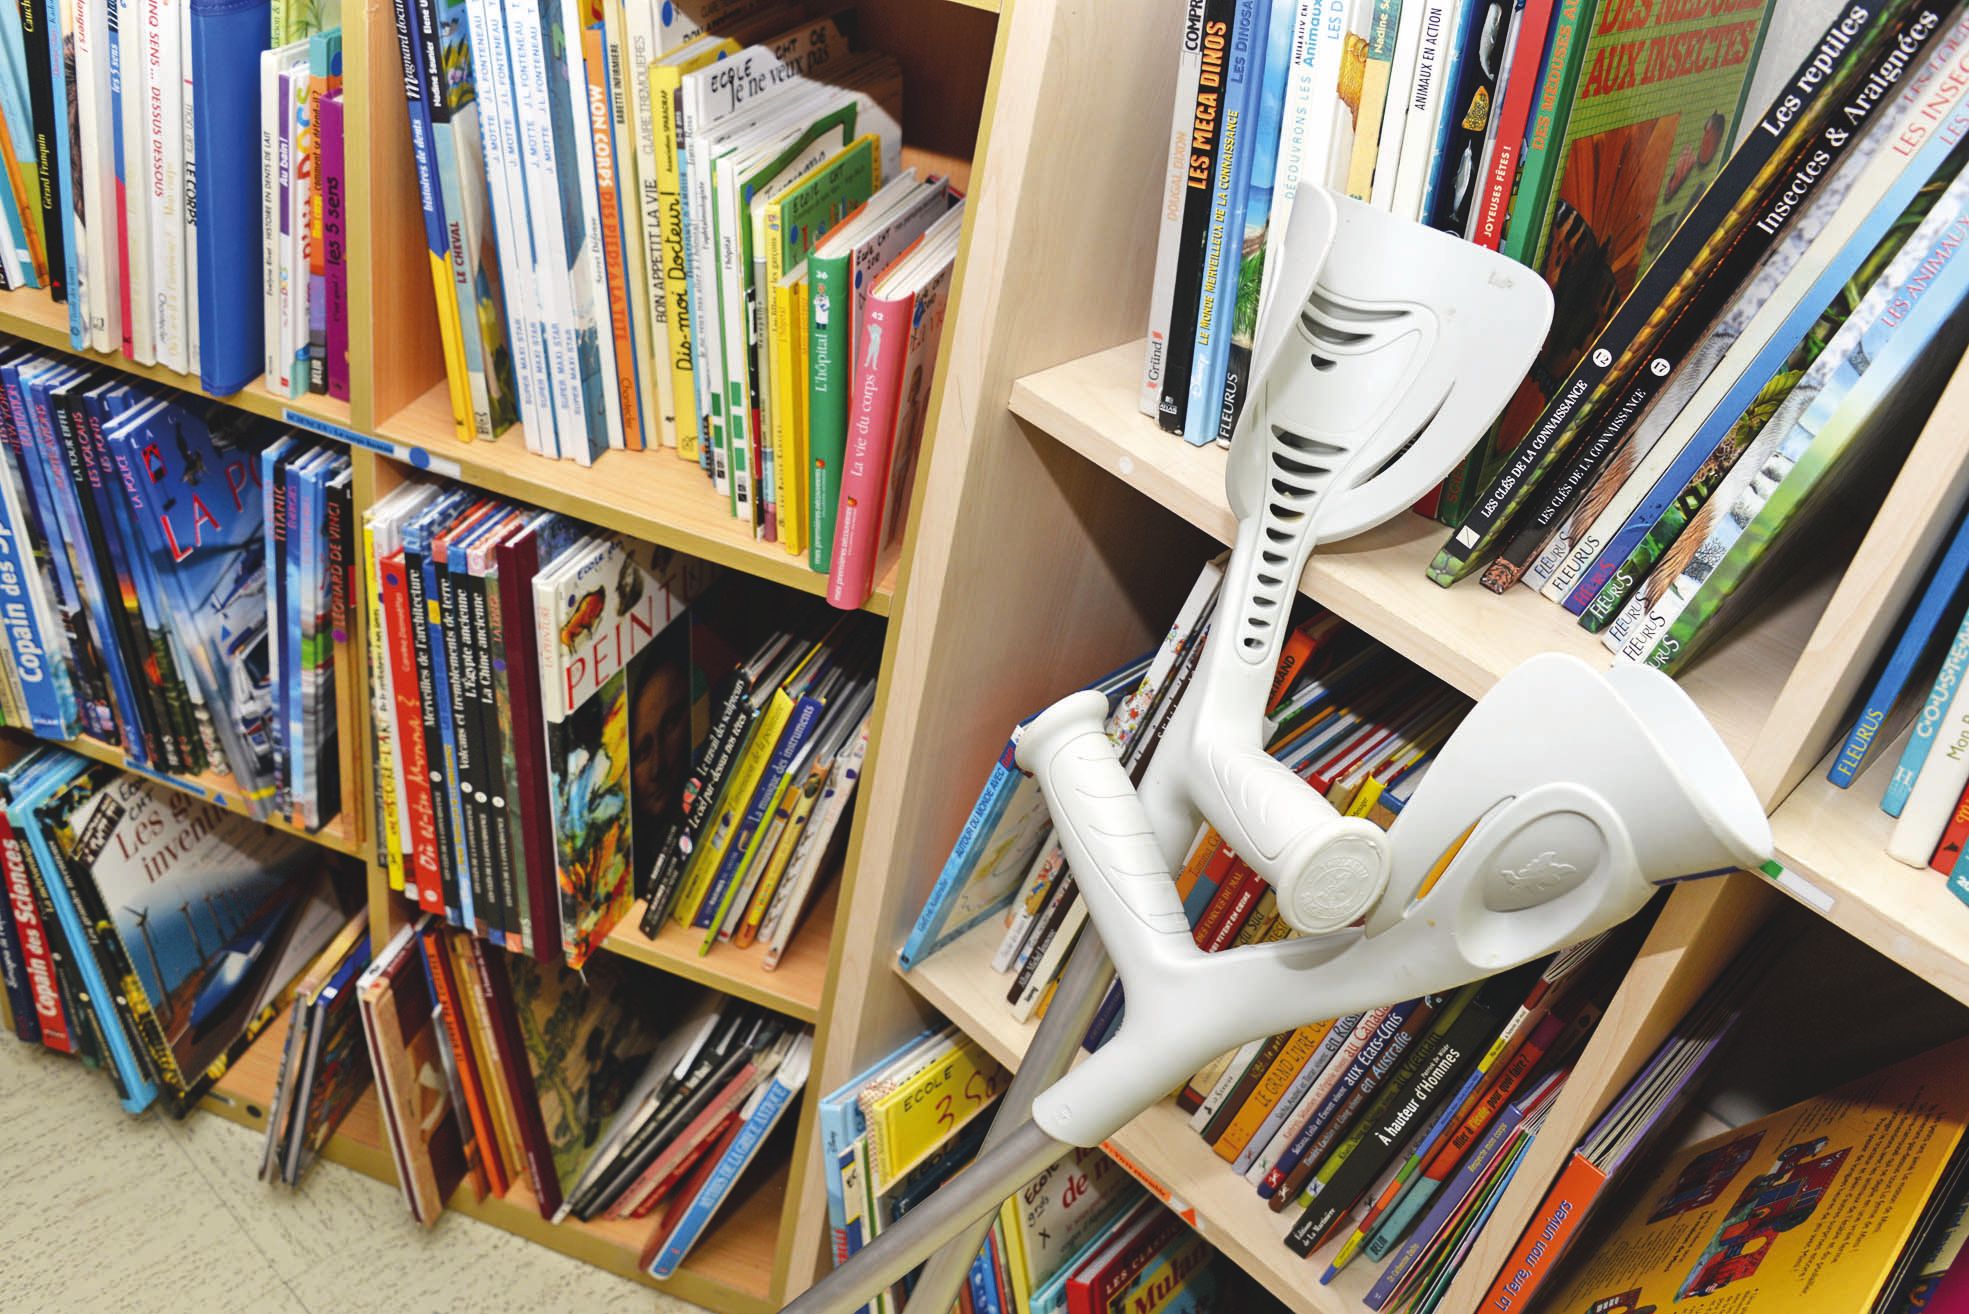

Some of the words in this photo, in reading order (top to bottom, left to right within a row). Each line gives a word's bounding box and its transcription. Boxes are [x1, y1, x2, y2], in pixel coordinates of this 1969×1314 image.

[1326, 14, 1342, 40] LES
[1424, 5, 1443, 45] ACTION
[110, 43, 119, 67] sens
[1197, 19, 1228, 87] DINOS
[1230, 55, 1247, 84] LES
[1422, 46, 1435, 61] EN
[1581, 38, 1650, 100] AUX
[1639, 17, 1758, 83] INSECTES
[110, 79, 120, 93] les
[748, 73, 767, 99] ne
[1412, 62, 1433, 110] ANIMAUX
[1761, 93, 1802, 140] Les
[1797, 3, 1870, 97] reptiles
[149, 86, 162, 135] DESSUS
[613, 91, 625, 125] BABETTE
[1190, 89, 1219, 150] MEGA
[1756, 147, 1832, 237] Insectes
[1825, 124, 1850, 151] &
[1842, 9, 1940, 128] Araignées
[1172, 131, 1189, 170] DIXON
[1218, 109, 1240, 190] CONNAISSANCE
[1280, 104, 1310, 200] DÉCOUVRONS
[1296, 74, 1312, 101] LES
[150, 139, 165, 198] DESSOUS
[184, 159, 196, 175] LE
[414, 148, 426, 163] de
[1185, 153, 1210, 190] LES
[39, 177, 53, 209] Gérard
[644, 179, 657, 203] VIE
[1165, 171, 1184, 221] DOUGAL
[1216, 191, 1228, 207] LA
[1482, 182, 1503, 238] JOYEUSES
[1493, 150, 1510, 181] FÊTES
[646, 209, 659, 227] LA
[1214, 207, 1226, 223] DE
[447, 221, 464, 267] CHEVAL
[648, 231, 663, 290] APPETIT
[1205, 223, 1225, 293] MERVEILLEUX
[455, 270, 466, 284] LE
[653, 294, 665, 323] BON
[1200, 296, 1215, 330] MONDE
[1881, 291, 1910, 329] LES
[512, 318, 524, 342] STAR
[550, 322, 562, 346] STAR
[1198, 330, 1210, 346] LE
[516, 345, 528, 370] MAXI
[554, 350, 565, 374] MAXI
[814, 333, 831, 391] L'hôpital
[1146, 340, 1163, 382] Gründ
[860, 373, 880, 413] corps
[1214, 372, 1244, 438] FLEURUS
[56, 407, 72, 438] EIFFEL
[71, 409, 96, 467] VOLCANS
[855, 414, 871, 434] du
[64, 439, 79, 467] TOUR
[853, 436, 867, 457] vie
[1479, 497, 1499, 519] LES
[1490, 474, 1515, 501] CLÉS
[1508, 462, 1525, 480] DE
[1517, 448, 1535, 467] LA
[1527, 383, 1584, 454] CONNAISSANCE
[1536, 504, 1556, 526] LES
[1547, 480, 1574, 509] CLÉS
[1567, 468, 1584, 485] DE
[1578, 454, 1595, 472] LA
[1588, 388, 1645, 459] CONNAISSANCE
[72, 468, 83, 483] LA
[88, 468, 101, 488] LES
[98, 454, 112, 474] LES
[114, 452, 138, 493] POLICE
[850, 461, 864, 477] La
[131, 494, 144, 510] LA
[270, 485, 290, 541] TITANIC
[328, 502, 341, 540] VINCI
[330, 545, 341, 561] DE
[1533, 529, 1574, 580] FLEURUS
[1551, 533, 1601, 593] FLEURUS
[1, 562, 20, 595] des
[436, 576, 453, 610] terre
[1589, 568, 1636, 622] FLEURUS
[402, 567, 432, 650] l'architecture
[441, 610, 454, 628] de
[454, 587, 472, 645] ancienne
[470, 591, 488, 649] ancienne
[1609, 591, 1653, 645] FLEURUS
[8, 604, 44, 684] Copain
[1622, 609, 1669, 663] FLEURUS
[415, 650, 429, 668] de
[441, 630, 466, 711] tremblements
[458, 645, 479, 698] L'Égypte
[475, 649, 492, 686] Chine
[396, 692, 420, 710] ?
[416, 668, 439, 728] Merveilles
[480, 687, 494, 705] La
[721, 677, 747, 724] sculpteurs
[453, 713, 465, 726] et
[713, 722, 727, 739] des
[780, 701, 817, 759] instruments
[454, 727, 470, 770] Volcans
[704, 737, 721, 765] travail
[1837, 707, 1885, 778] FLEURUS
[688, 813, 702, 829] Le
[695, 798, 709, 816] ciel
[723, 735, 737, 754] nos
[699, 764, 710, 778] Le
[771, 755, 789, 775] des
[988, 766, 1006, 788] AVEC
[755, 772, 783, 811] musique
[974, 786, 996, 817] MONDE
[748, 807, 764, 823] La
[969, 815, 981, 828] DU
[418, 843, 438, 873] Où
[953, 826, 975, 858] AUTOUR
[2, 838, 38, 926] Sciences
[1243, 908, 1267, 932] Sud
[25, 922, 45, 955] des
[36, 953, 59, 1017] Copain
[1287, 1032, 1318, 1065] LIVRE
[1322, 1036, 1340, 1054] en
[1342, 1041, 1360, 1059] au
[1367, 1027, 1413, 1083] Australie
[1432, 1054, 1441, 1063] De
[1436, 1042, 1451, 1058] Wilde
[1262, 1057, 1298, 1096] GRAND
[1358, 1075, 1377, 1096] en
[1418, 1061, 1436, 1080] Patrick
[904, 1064, 954, 1113] ECOLE
[1253, 1089, 1273, 1109] LE
[1373, 1128, 1392, 1146] À
[1383, 1096, 1420, 1137] hauteur
[1412, 1045, 1461, 1101] d'Hommes
[1450, 1129, 1470, 1150] Aller
[1485, 1089, 1504, 1109] pour
[1496, 1073, 1516, 1094] quoi
[1507, 1057, 1528, 1079] faire
[1483, 1136, 1497, 1152] mon
[1492, 1121, 1509, 1140] corps
[1062, 1173, 1089, 1210] de
[1536, 1195, 1574, 1242] univers
[1522, 1237, 1549, 1268] mon
[1106, 1268, 1129, 1296] LES
[1501, 1262, 1533, 1299] Terre,
[1492, 1292, 1513, 1313] La
